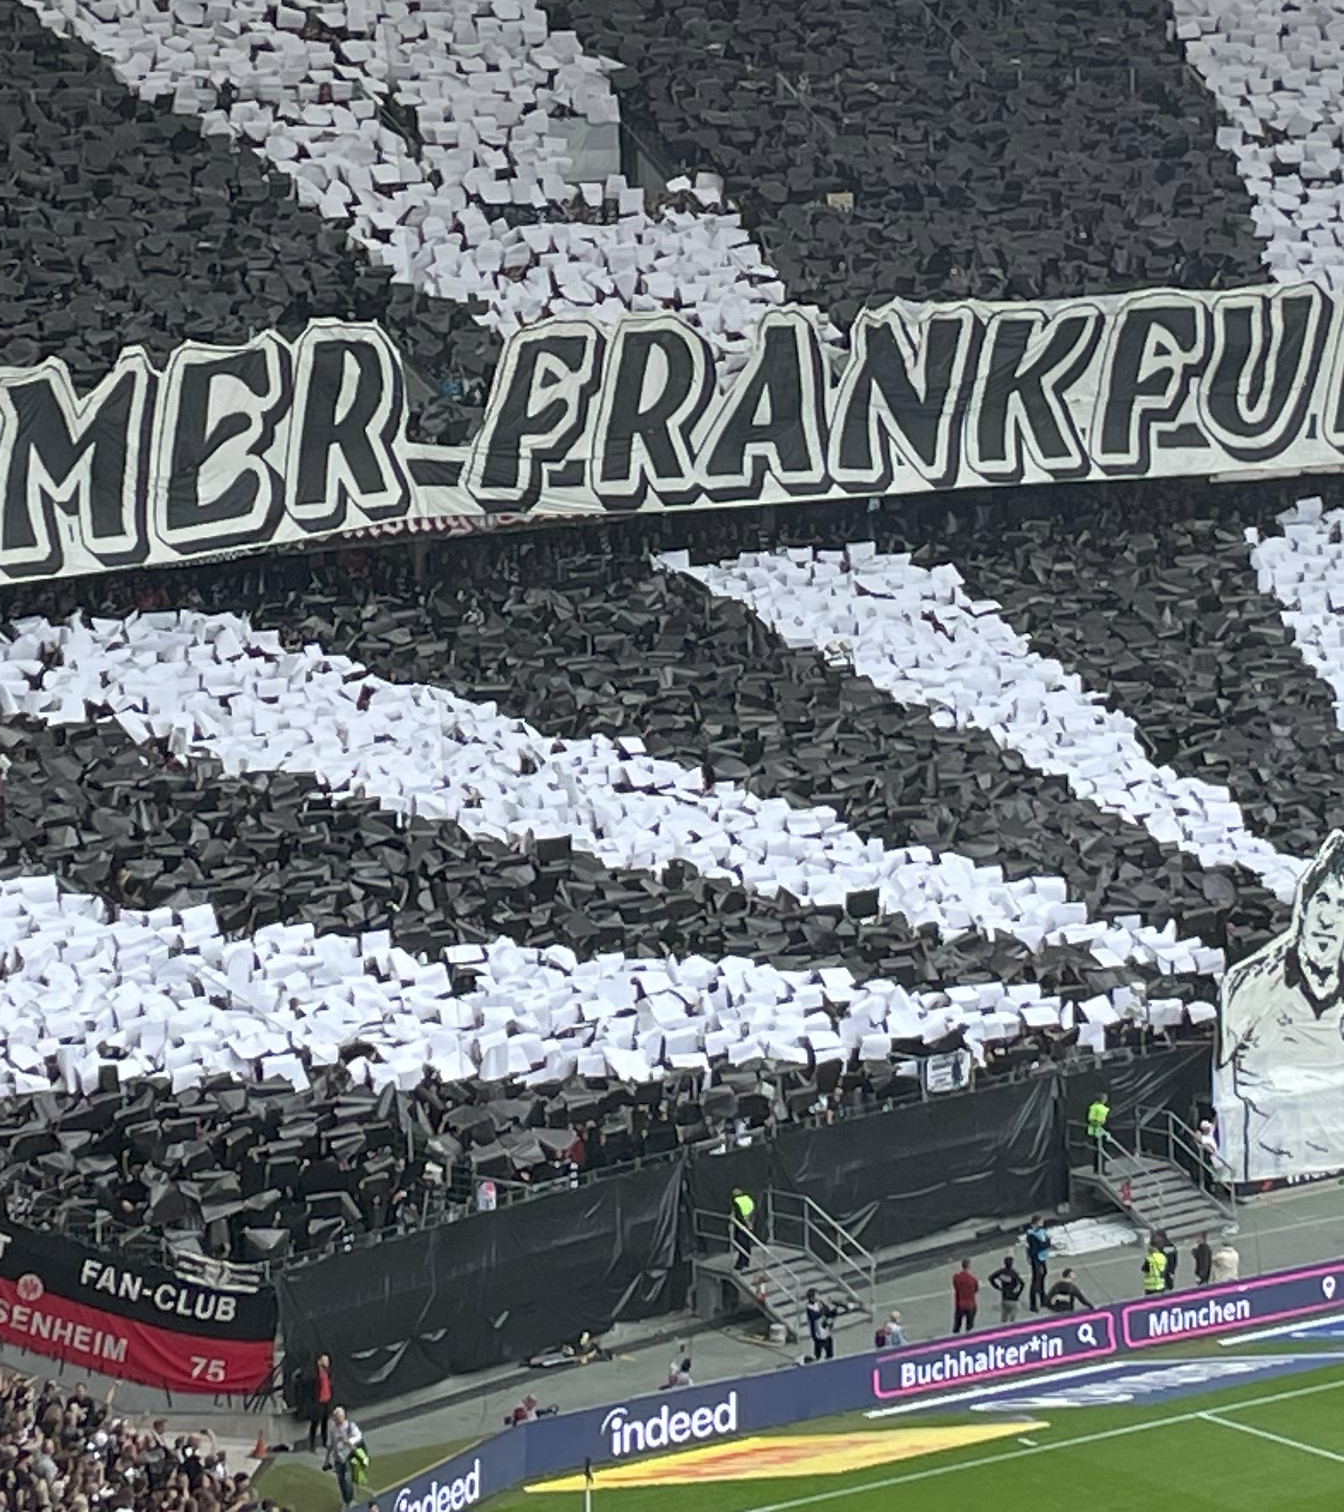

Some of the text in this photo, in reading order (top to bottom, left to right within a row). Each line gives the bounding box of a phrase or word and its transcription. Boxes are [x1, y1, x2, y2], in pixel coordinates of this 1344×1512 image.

[80, 1259, 236, 1322] FAN-CLUB
[1149, 1297, 1250, 1339] München
[190, 1356, 226, 1383] 75
[600, 1390, 738, 1457] indeed
